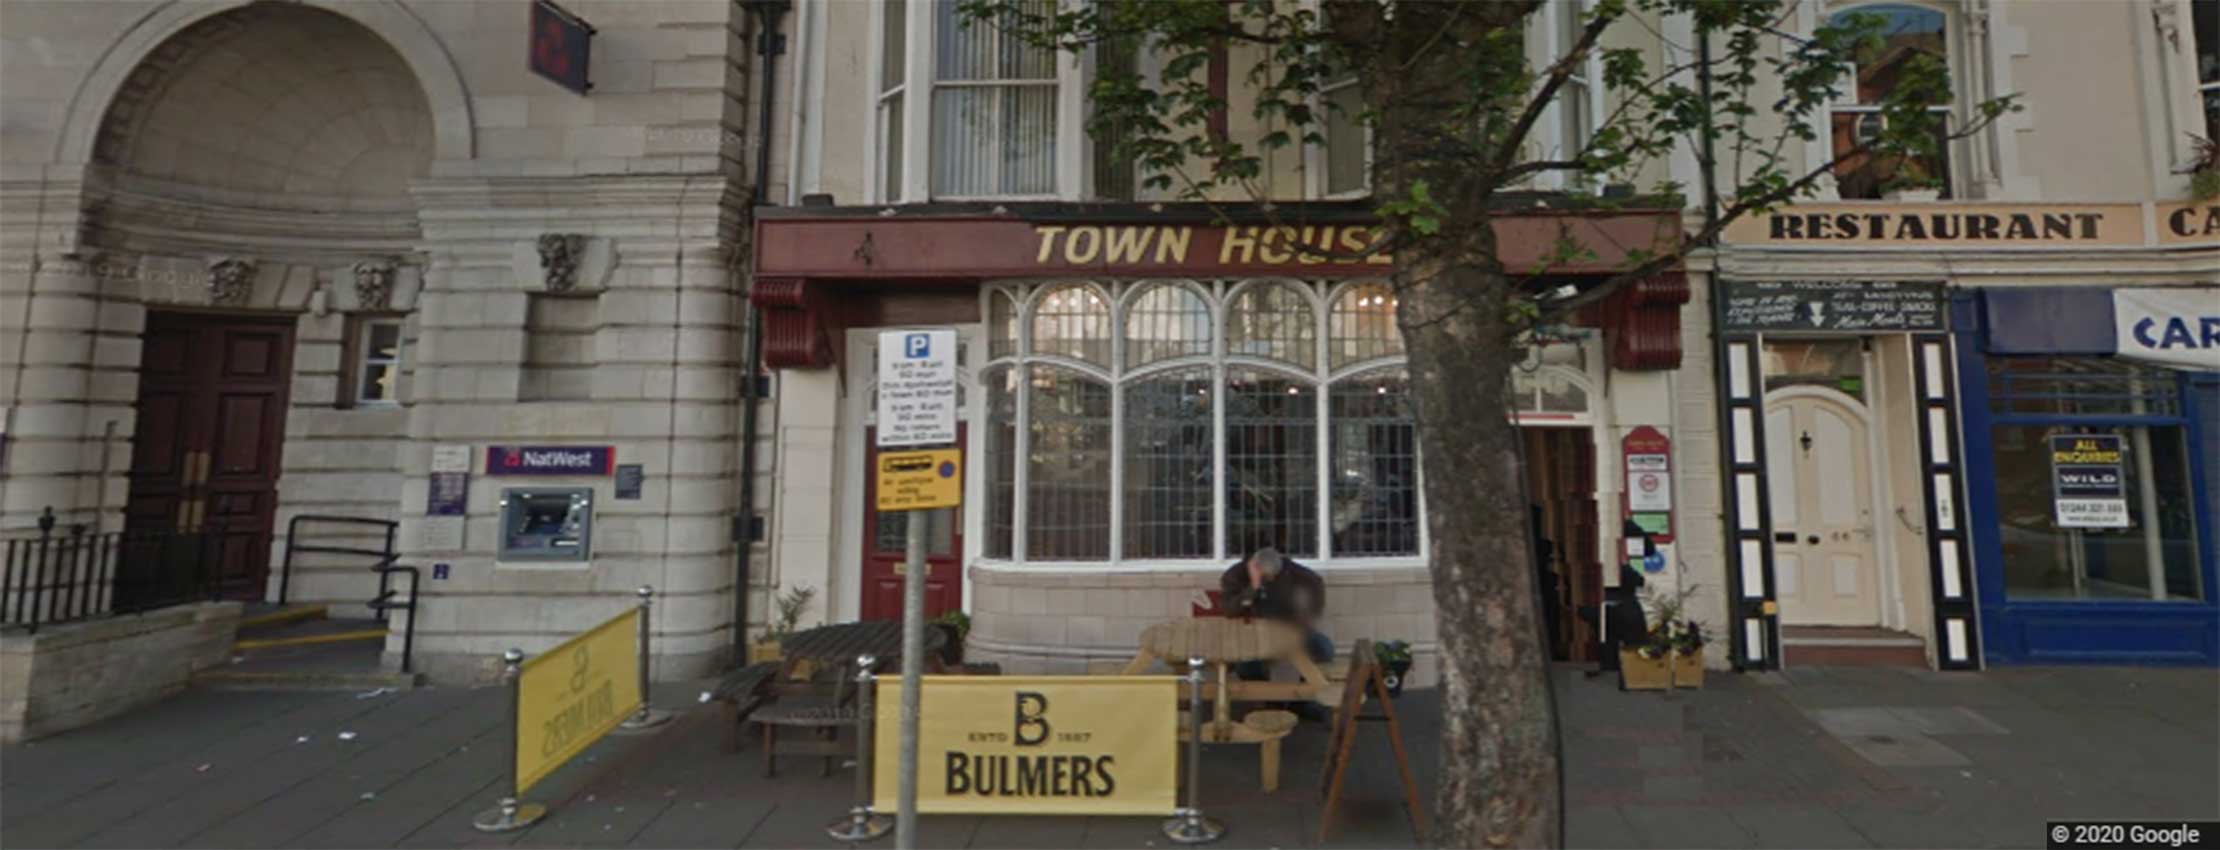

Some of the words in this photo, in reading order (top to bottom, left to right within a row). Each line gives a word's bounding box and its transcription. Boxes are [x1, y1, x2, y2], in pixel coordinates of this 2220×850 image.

[1769, 213, 2103, 240] RESTAURANT
[1034, 226, 1192, 264] TOWN
[2074, 440, 2098, 451] ALL
[522, 451, 593, 468] NatWest
[2060, 474, 2117, 483] WILD
[945, 750, 1116, 797] BULMERS
